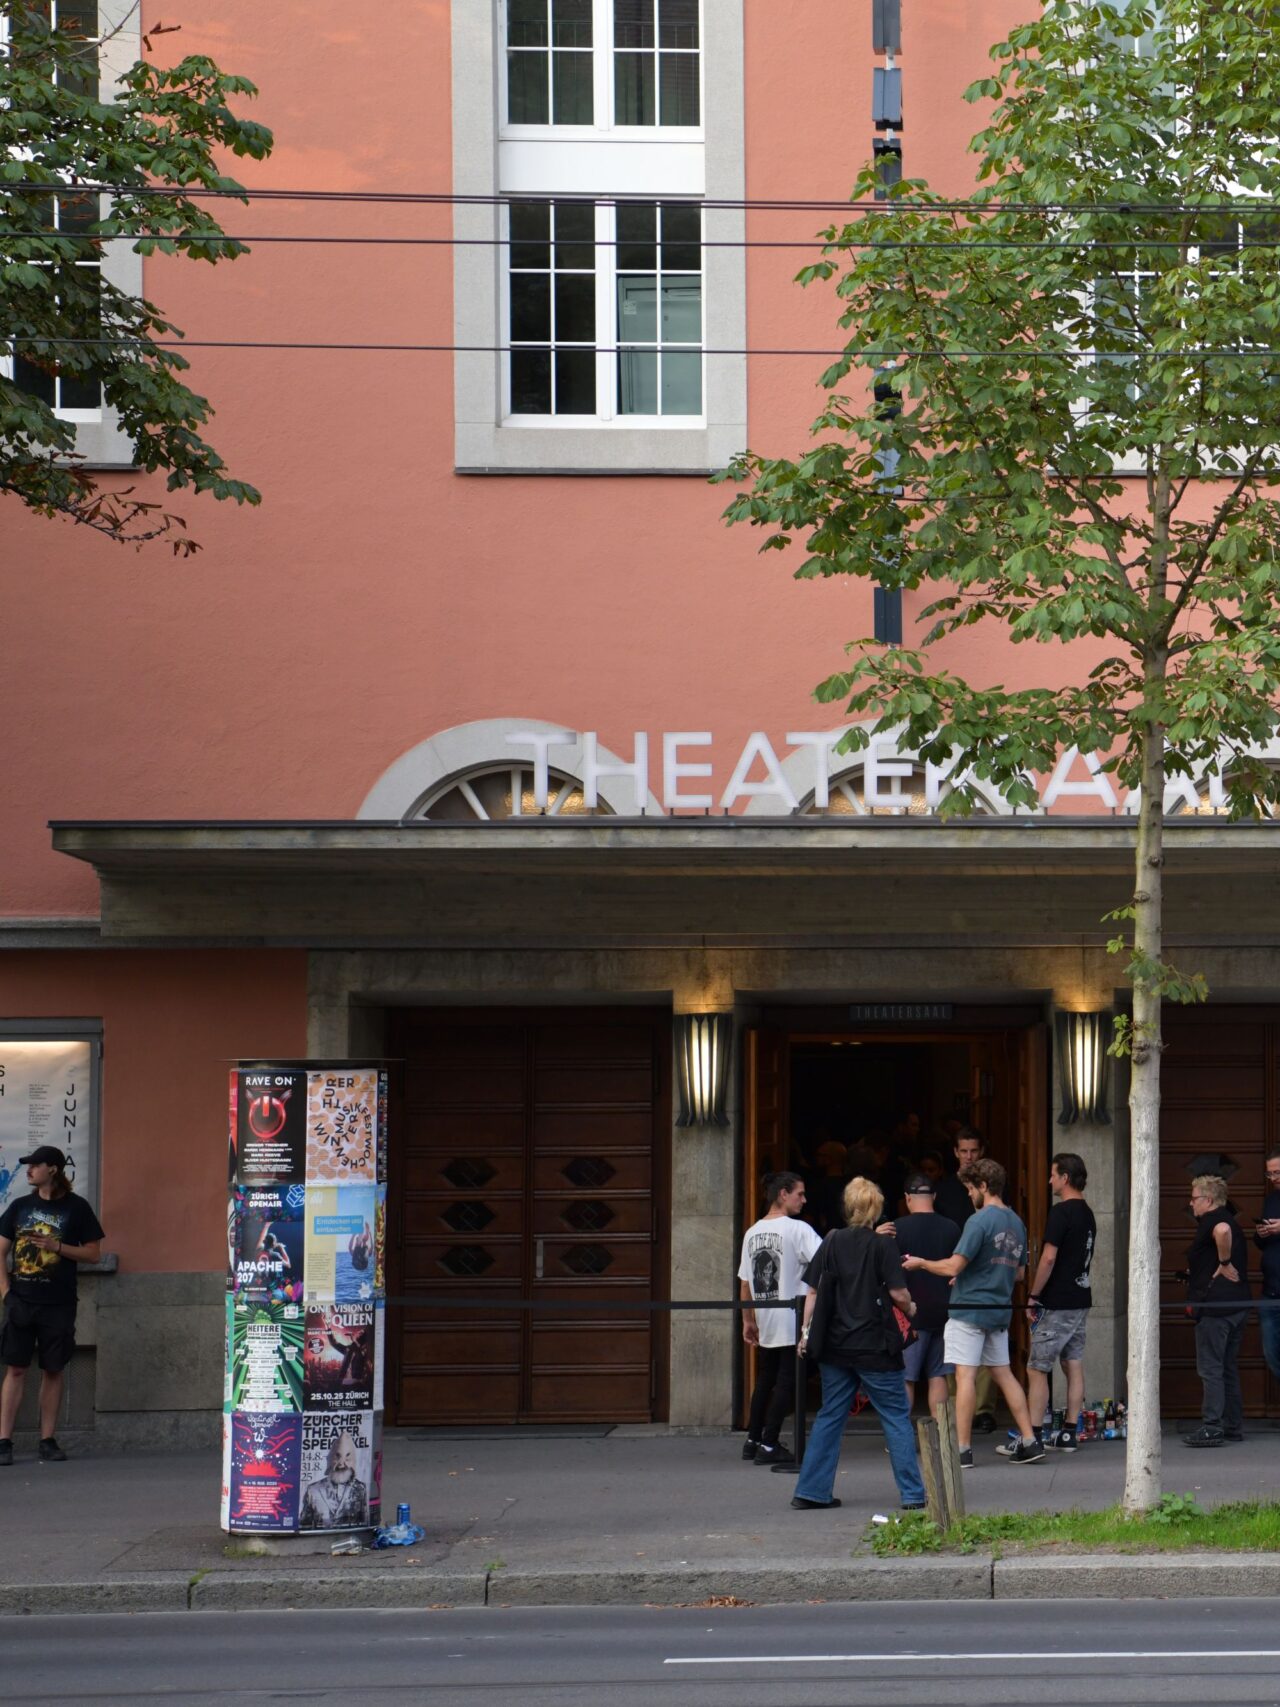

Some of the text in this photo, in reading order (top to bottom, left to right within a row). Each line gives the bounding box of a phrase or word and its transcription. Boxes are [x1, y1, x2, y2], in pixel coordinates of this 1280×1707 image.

[855, 1005, 946, 1019] THEATERSAAL
[245, 1076, 293, 1086] RAVE ON
[251, 1192, 279, 1200] ZÜRICH
[249, 1200, 282, 1208] OPENAIR
[237, 1261, 283, 1272] APACHE
[237, 1272, 254, 1283] 207
[332, 1303, 363, 1313] VISION
[332, 1312, 373, 1328] QUEEN
[310, 1390, 369, 1400] 25.10.25 ZÜRICH
[303, 1414, 362, 1427] ZÜRCHER
[303, 1426, 360, 1438] THEATER
[303, 1437, 369, 1450] SPEKKEL
[302, 1462, 322, 1471] 31.8.
[301, 1472, 313, 1482] 25
